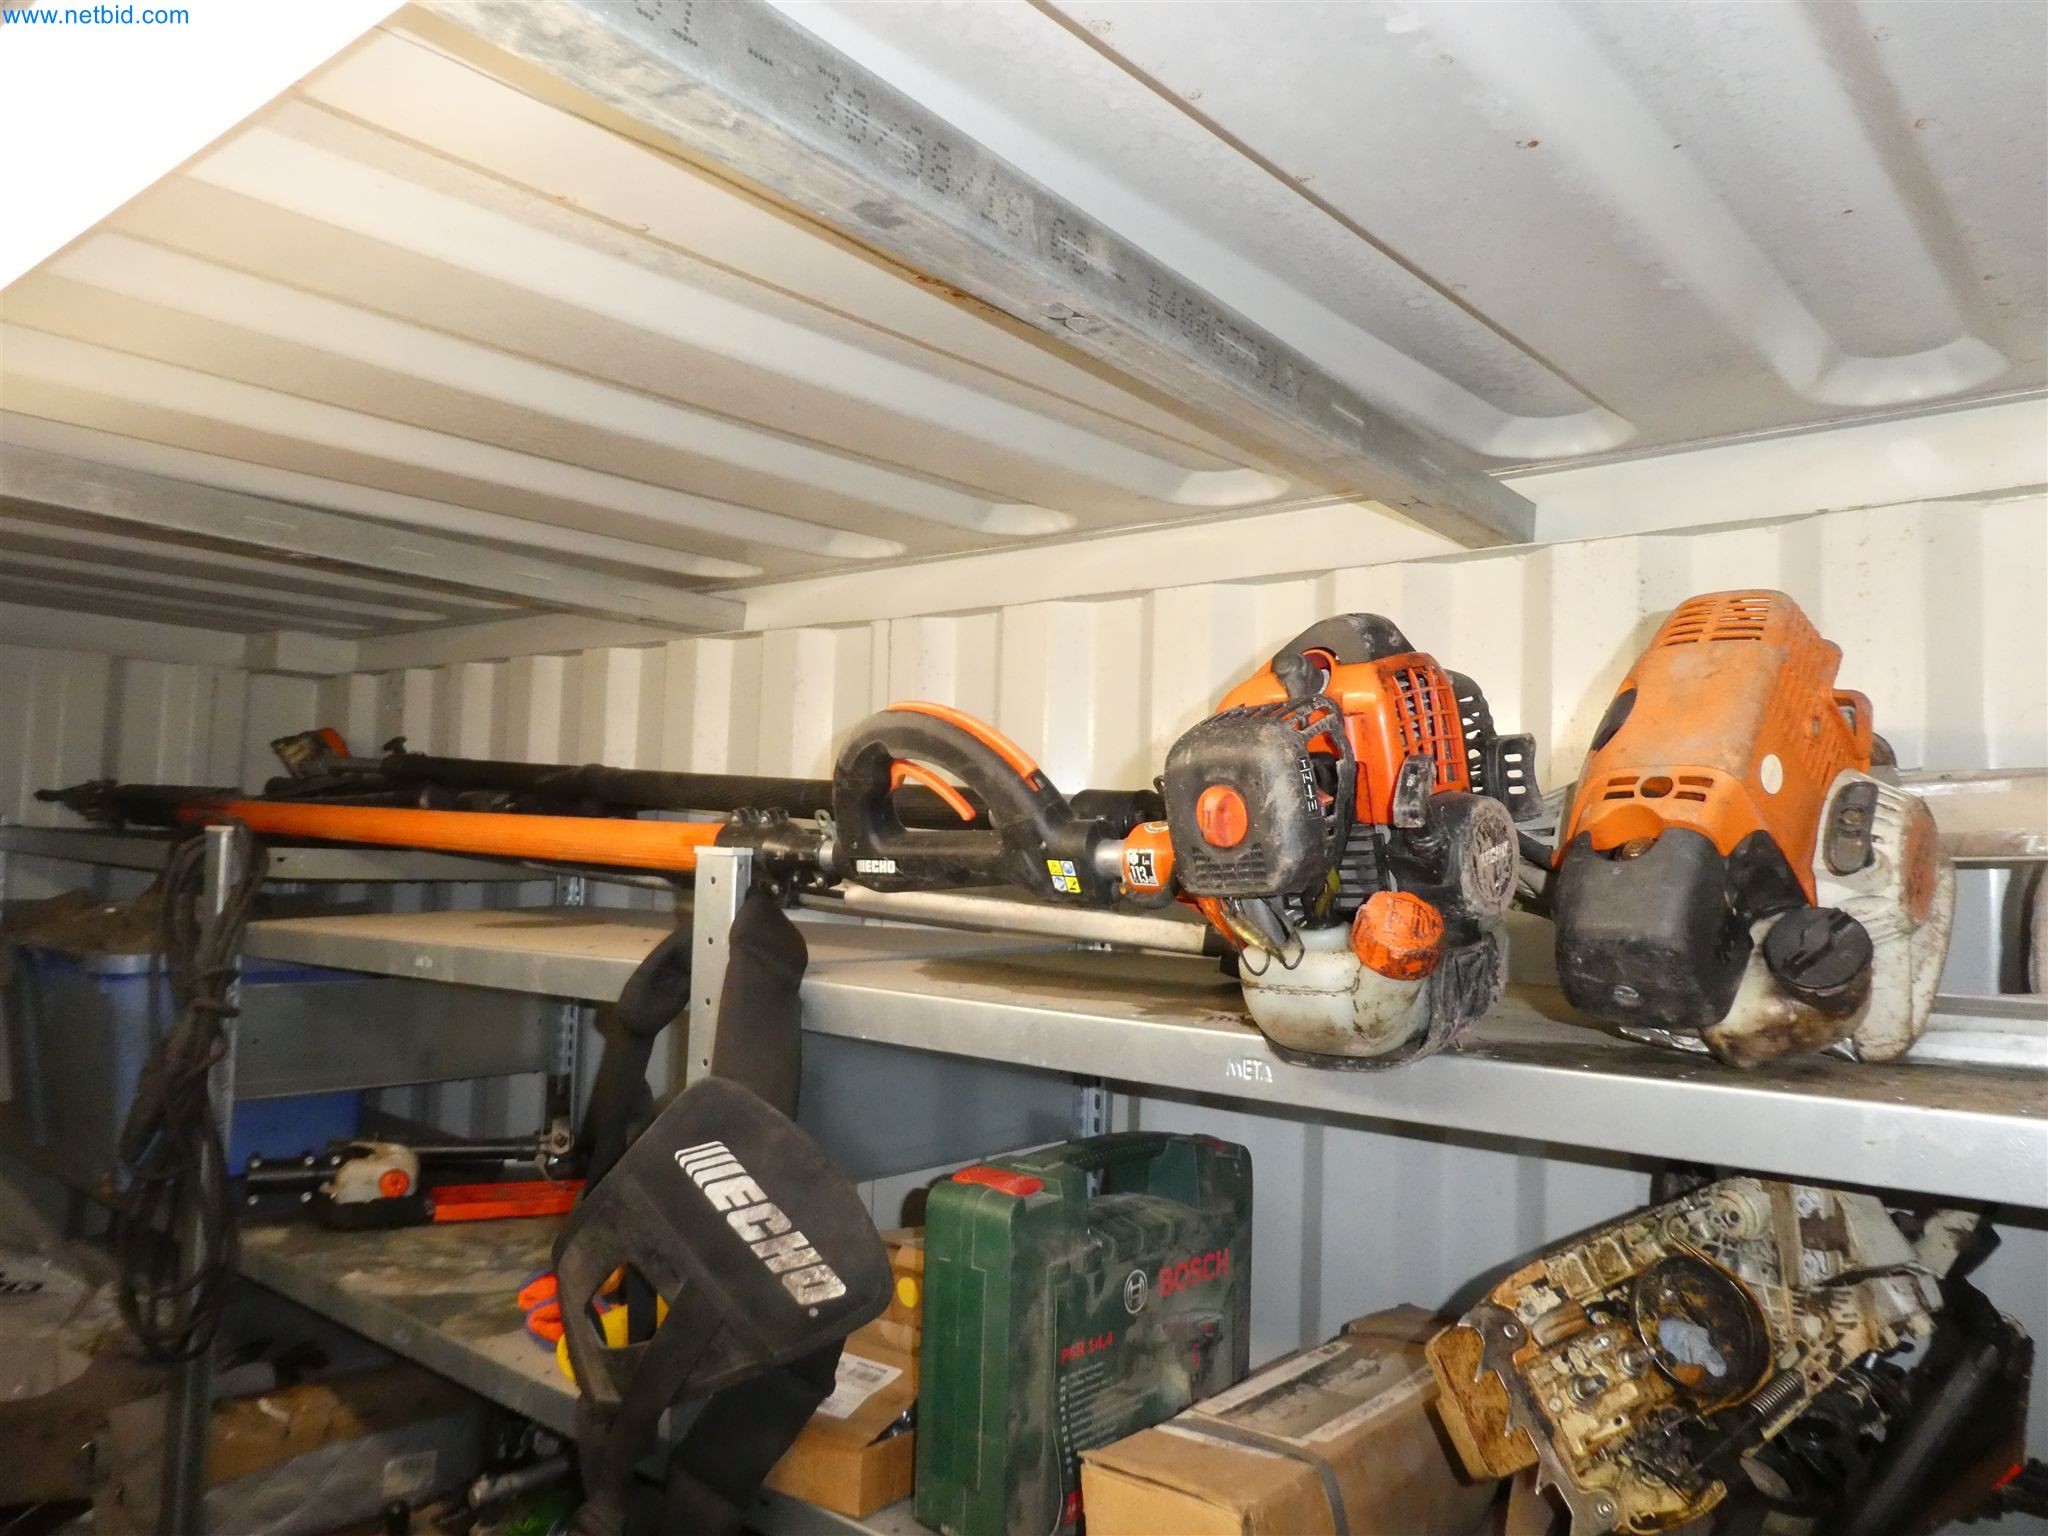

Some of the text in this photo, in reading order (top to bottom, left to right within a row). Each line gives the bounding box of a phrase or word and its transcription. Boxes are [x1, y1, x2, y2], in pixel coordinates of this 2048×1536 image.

[864, 859, 896, 874] ECHO
[700, 1160, 848, 1307] ECHO
[1158, 1247, 1231, 1297] BOSCH
